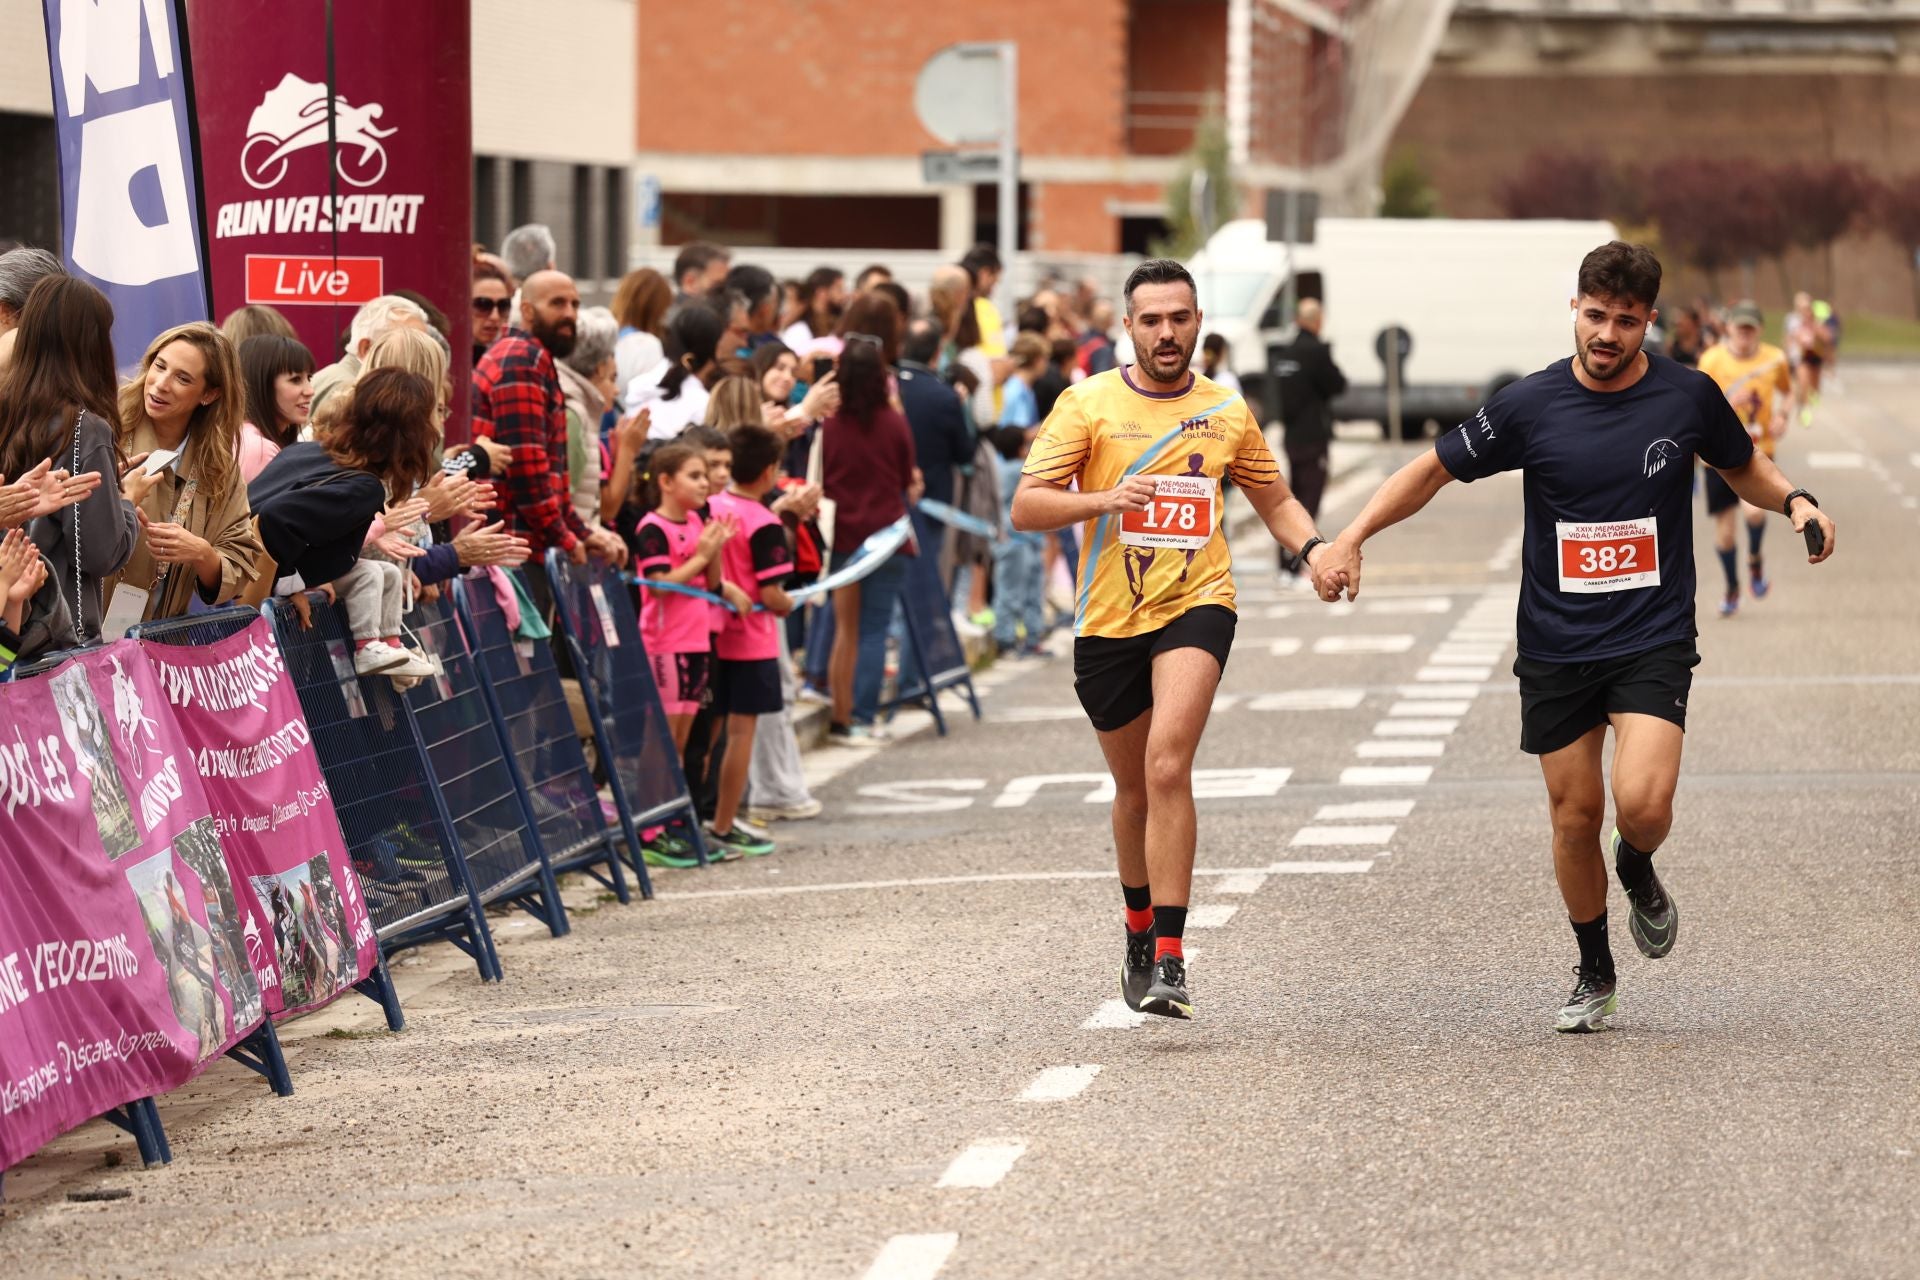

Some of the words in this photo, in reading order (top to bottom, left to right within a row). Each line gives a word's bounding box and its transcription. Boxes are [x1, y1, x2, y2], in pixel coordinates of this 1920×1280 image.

[216, 194, 425, 239] RUNVASPORT
[274, 261, 349, 296] Live
[1181, 431, 1225, 442] VALLADOLID
[1160, 480, 1200, 489] MEMORIAL
[1156, 487, 1206, 496] -MATARRANZ
[1142, 501, 1196, 530] 178
[1568, 528, 1647, 540] VIDAL-MATARRANZ
[1595, 523, 1638, 533] MEMORIAL
[1579, 544, 1638, 573] 382
